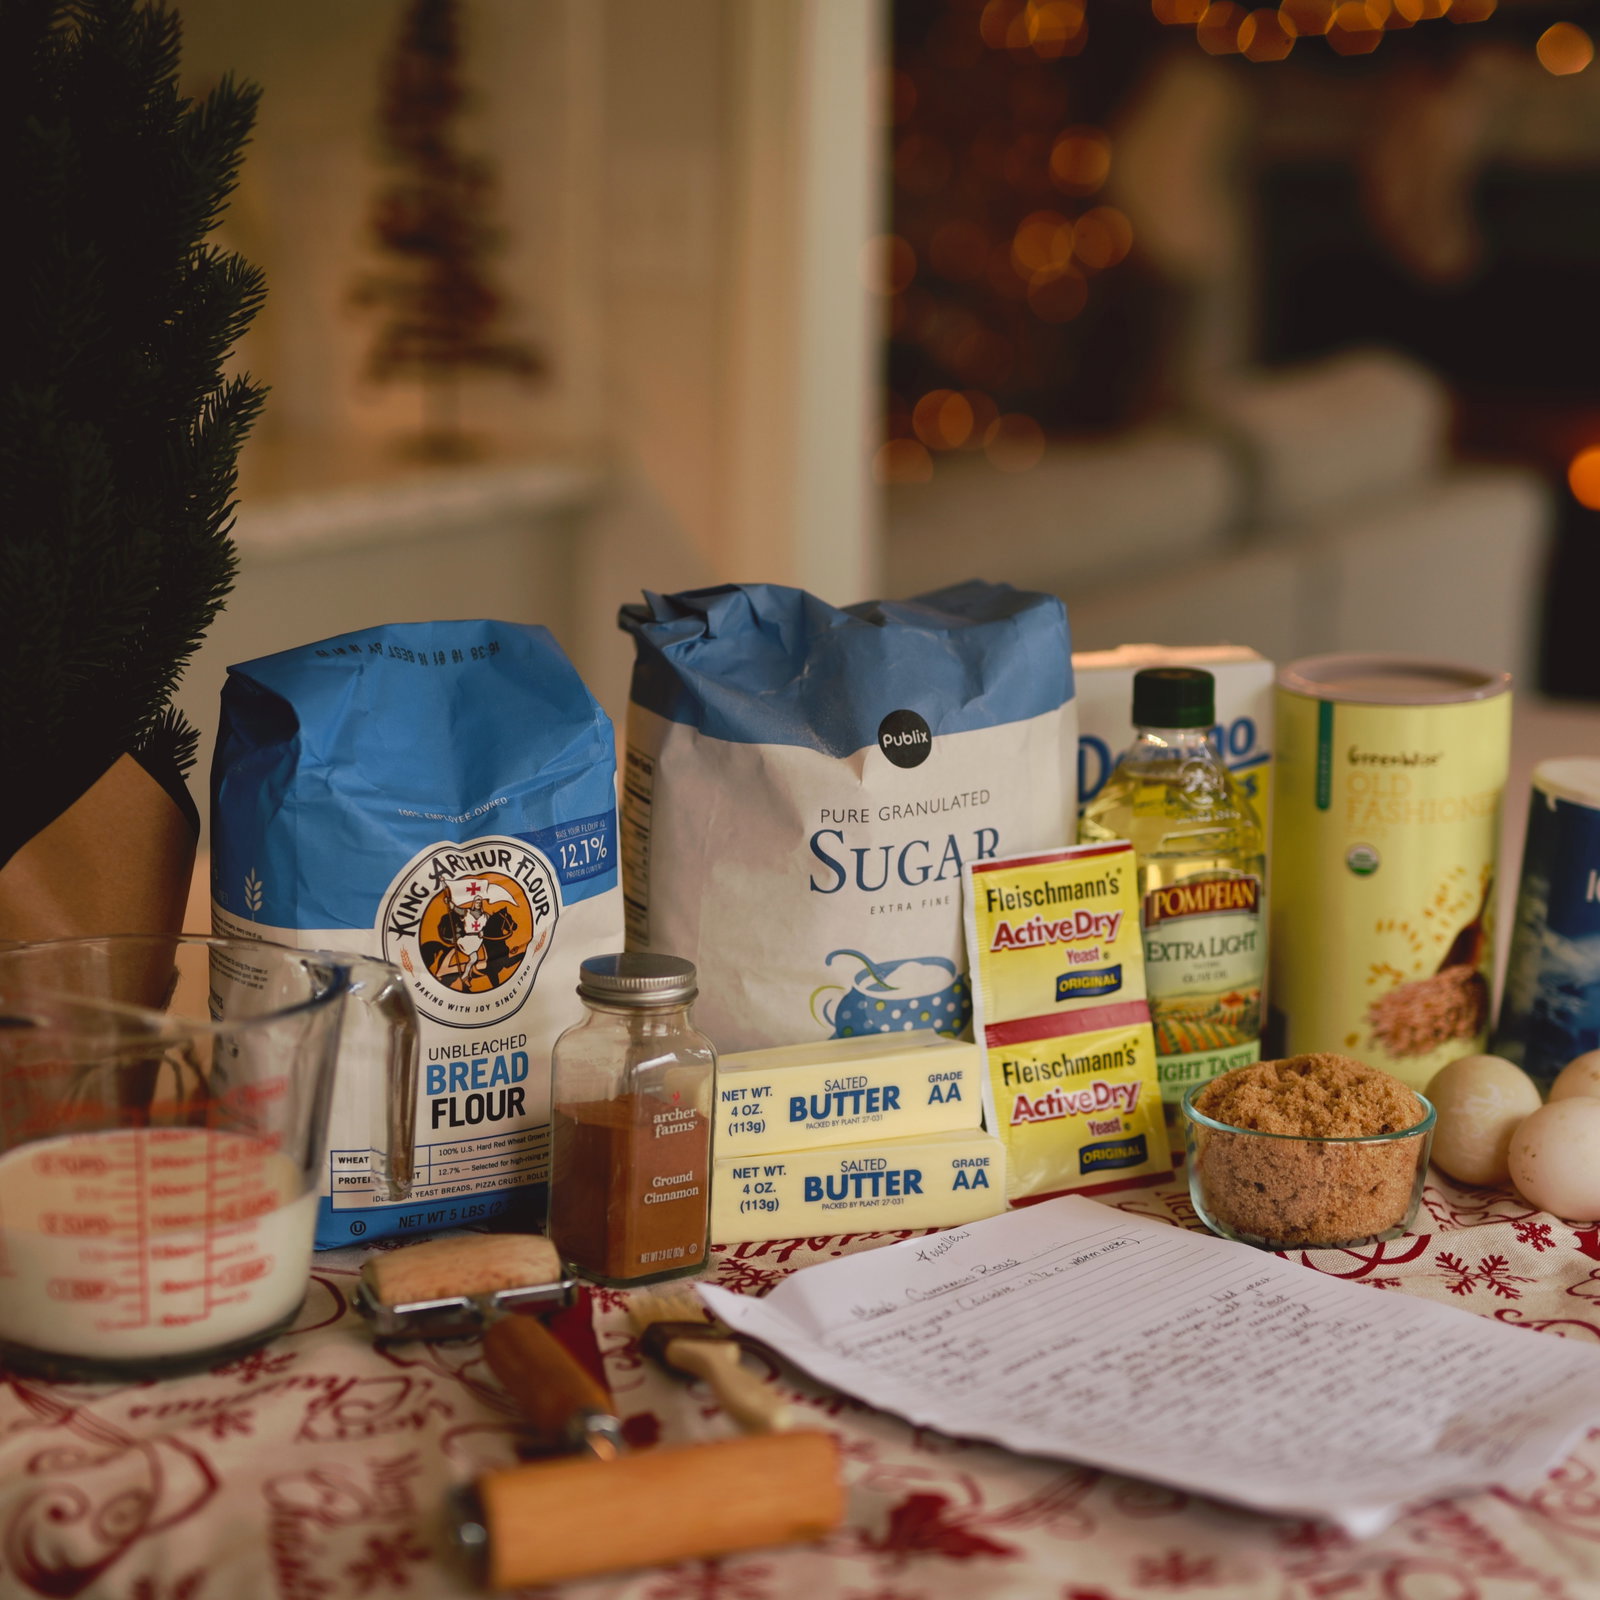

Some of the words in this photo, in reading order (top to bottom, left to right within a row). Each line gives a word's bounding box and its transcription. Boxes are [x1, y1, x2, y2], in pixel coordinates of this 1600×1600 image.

[883, 730, 929, 747] Publix
[821, 809, 870, 823] PURE
[878, 789, 990, 821] GRANULATED
[388, 882, 430, 941] KING
[428, 850, 512, 890] ARTHUR
[514, 855, 550, 925] FLOUR
[986, 872, 1120, 913] Fleischmann's
[1153, 880, 1255, 918] POMPEIAN
[871, 903, 912, 914] EXTRA
[922, 896, 949, 907] FINE
[1147, 941, 1206, 962] EXTRA
[1210, 930, 1257, 957] LIGHT
[1066, 946, 1100, 965] Yeast
[1059, 974, 1118, 992] ORIGINAL
[414, 981, 444, 1007] BAKING
[447, 1000, 470, 1013] WITH
[475, 1004, 491, 1013] JOY
[495, 989, 518, 1008] SINCE
[428, 1033, 527, 1060] UNBLEACHED
[426, 1051, 529, 1095] BREAD
[1002, 1043, 1137, 1086] Fleischmann's
[824, 1076, 868, 1092] SALTED
[928, 1071, 963, 1083] GRADE
[722, 1089, 747, 1102] NET
[751, 1086, 773, 1098] WT.
[928, 1082, 962, 1105] AA
[432, 1087, 526, 1129] FLOUR
[731, 1107, 738, 1117] 4
[742, 1104, 763, 1116] OZ.
[789, 1085, 901, 1123] BUTTER
[653, 1107, 697, 1124] archer
[806, 1121, 830, 1130] PACKED
[831, 1119, 840, 1127] BY
[841, 1117, 860, 1126] PLANT
[862, 1115, 883, 1124] 27-031
[655, 1121, 698, 1138] farms
[728, 1120, 766, 1136] (113g)
[1087, 1117, 1122, 1137] Yeast
[477, 1143, 492, 1151] Hard
[507, 1137, 527, 1145] Wheat
[338, 1156, 369, 1164] WHEAT
[952, 1157, 990, 1168] GRADE
[1082, 1145, 1142, 1164] ORIGINAL
[438, 1167, 460, 1176] 12.7%
[472, 1163, 499, 1171] Selected
[733, 1167, 760, 1179] NET
[764, 1165, 786, 1176] WT.
[840, 1158, 887, 1173] SALTED
[652, 1170, 693, 1188] Ground
[804, 1169, 924, 1202] BUTTER
[952, 1168, 990, 1191] AA
[441, 1186, 473, 1194] BREADS,
[644, 1186, 699, 1204] Cinnamon
[743, 1184, 750, 1195] 4
[754, 1182, 776, 1194] OZ.
[740, 1198, 779, 1213] (113g)
[821, 1203, 848, 1211] PACKED
[881, 1198, 904, 1206] 27-031
[398, 1213, 424, 1229] NET
[427, 1210, 446, 1224] WT
[449, 1208, 457, 1220] 5
[461, 1204, 486, 1218] LBS
